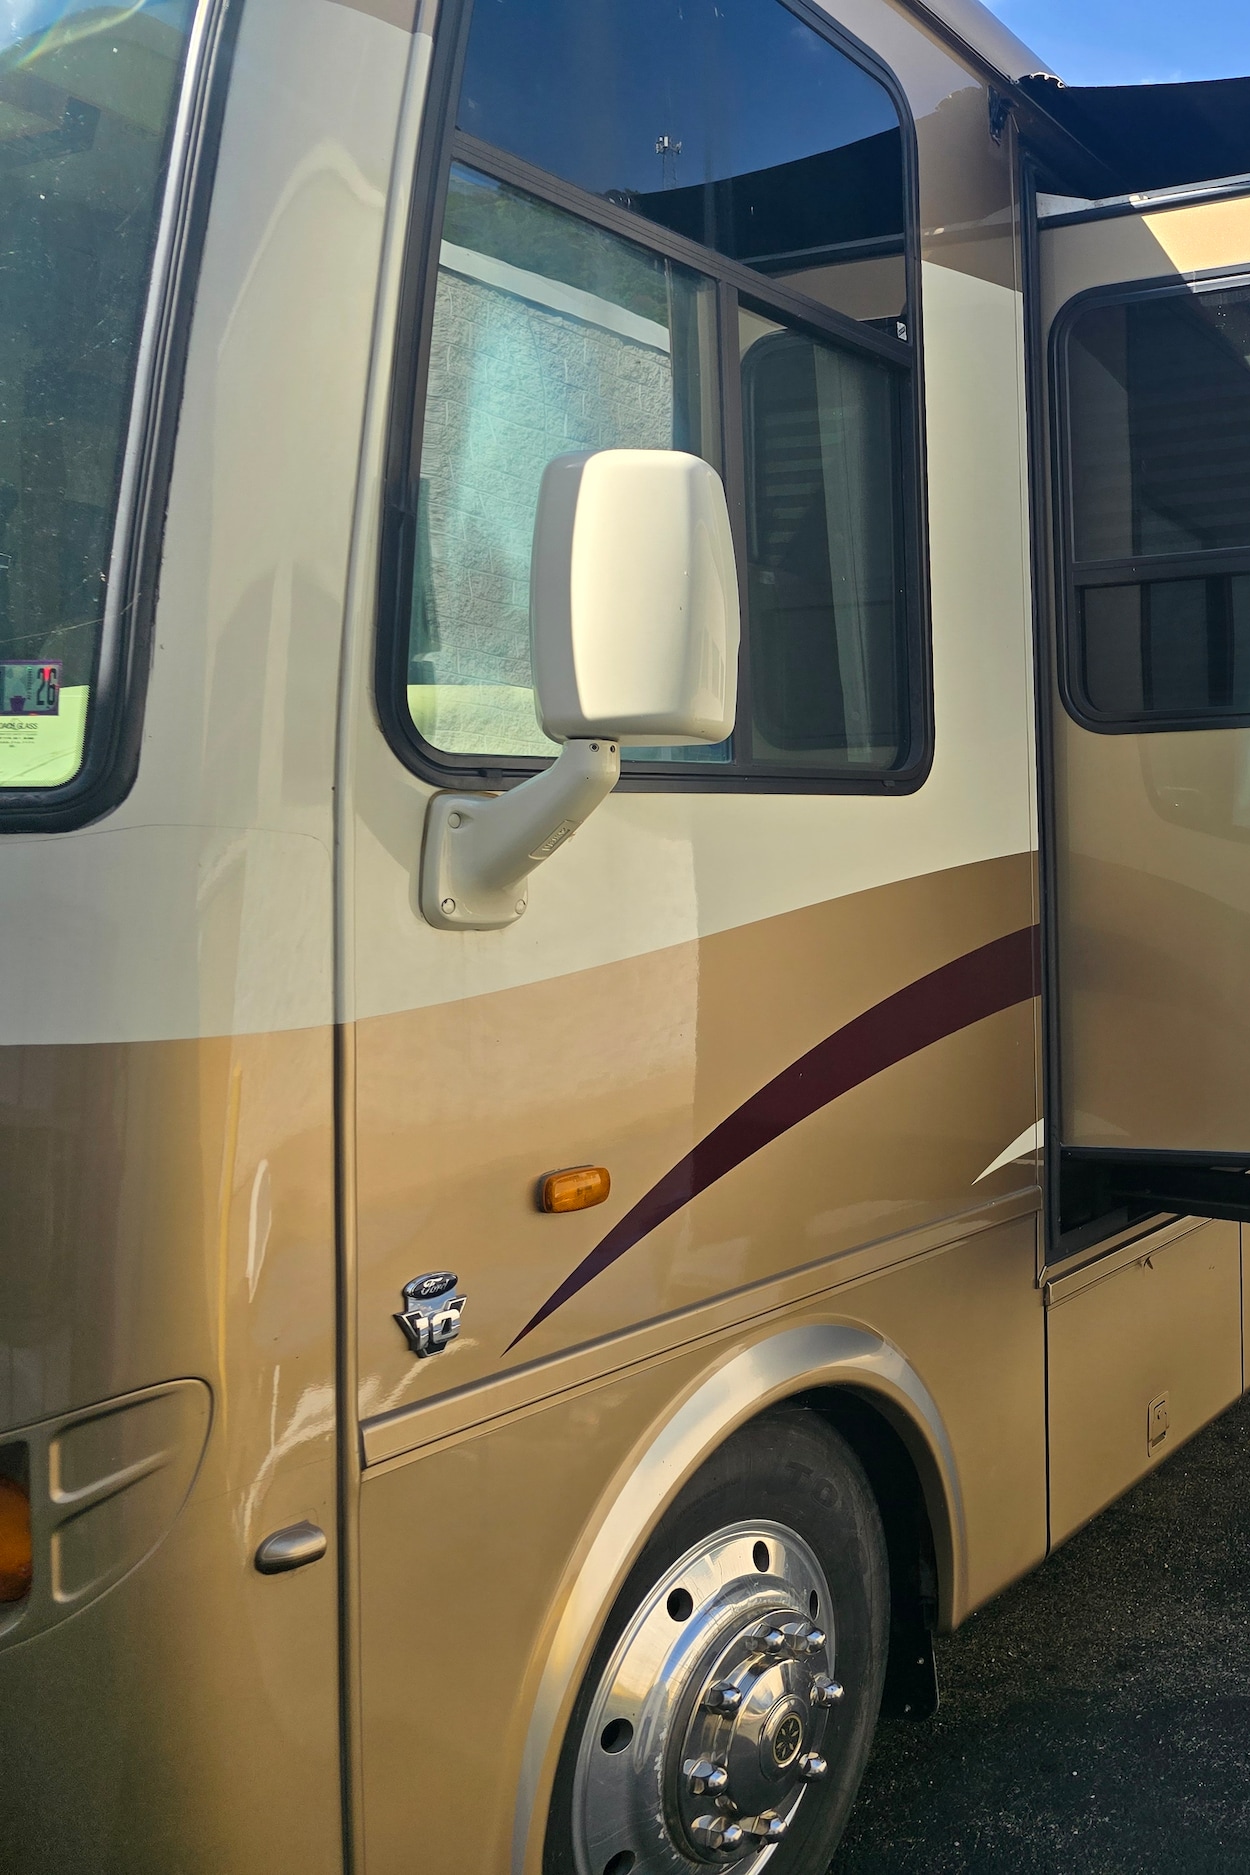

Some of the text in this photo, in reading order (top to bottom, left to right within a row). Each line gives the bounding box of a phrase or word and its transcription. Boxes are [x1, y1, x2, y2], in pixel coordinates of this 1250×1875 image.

[36, 667, 57, 706] 26
[16, 722, 39, 730] GLASS
[421, 1277, 450, 1295] Ford
